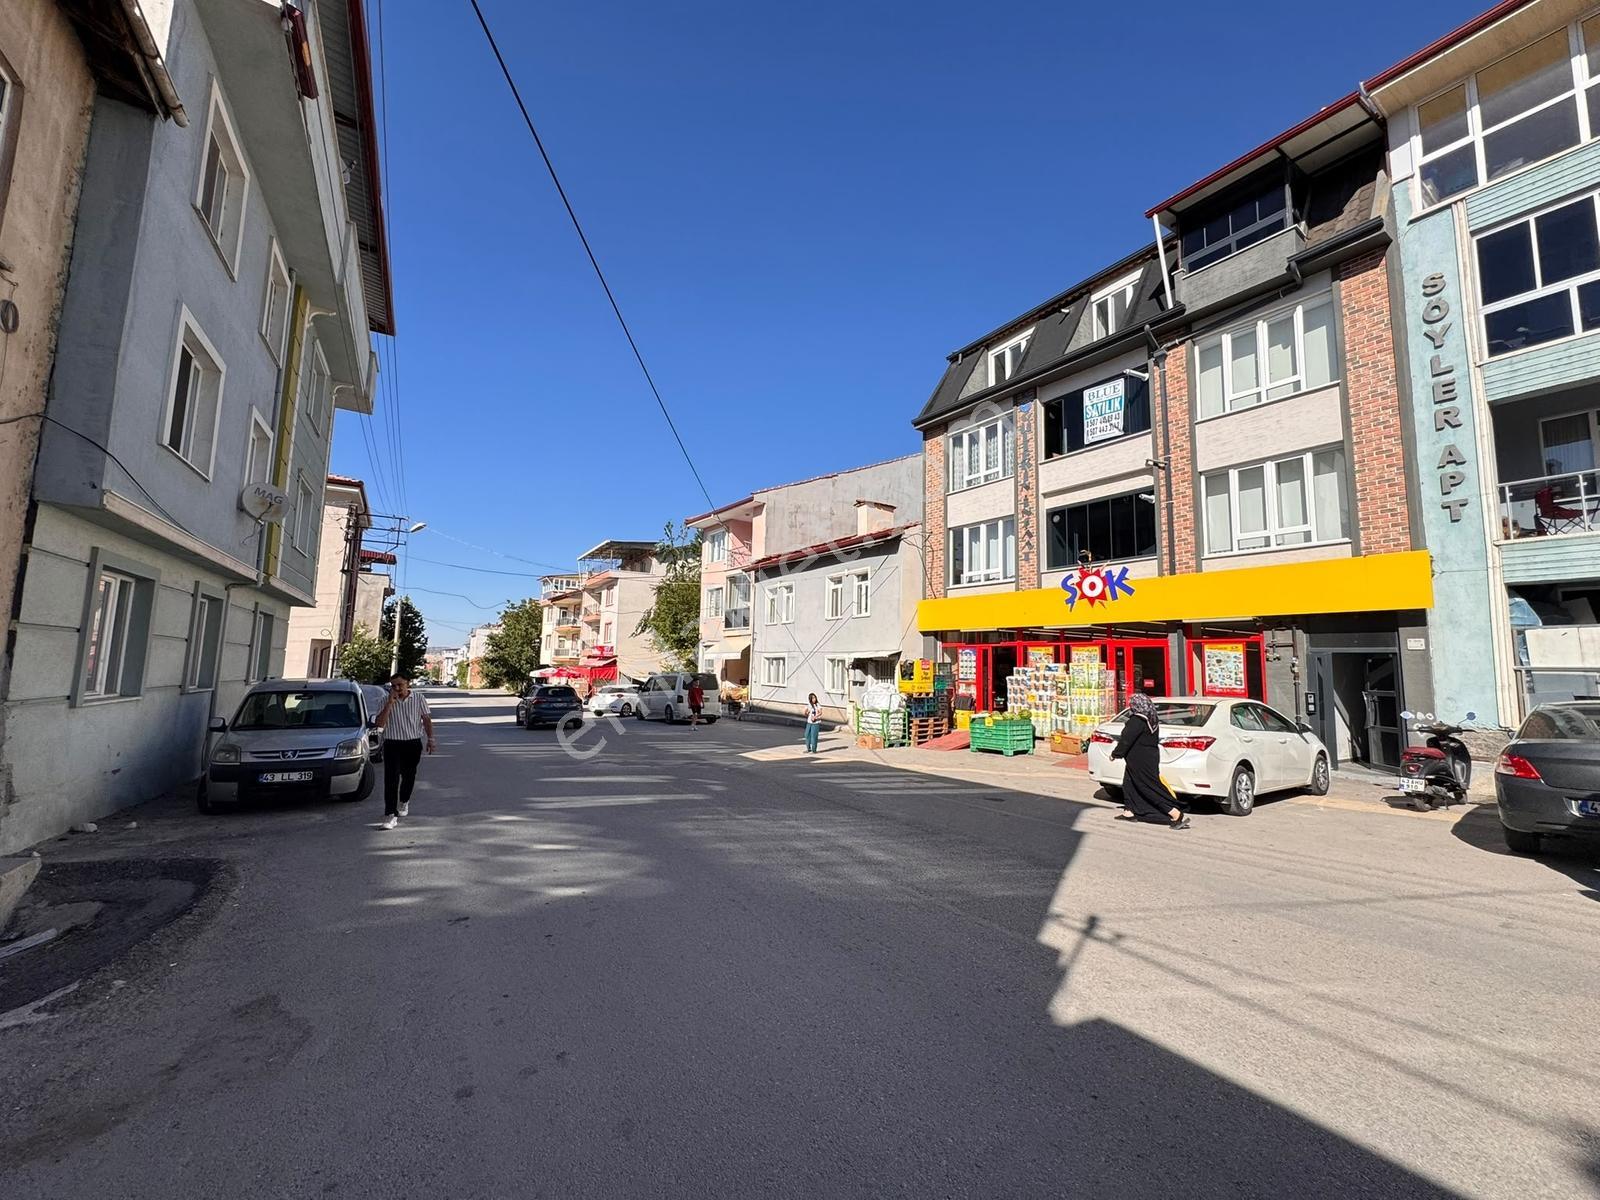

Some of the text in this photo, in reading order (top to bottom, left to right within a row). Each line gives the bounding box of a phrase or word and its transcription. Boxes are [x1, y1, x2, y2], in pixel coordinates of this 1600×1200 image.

[1087, 384, 1121, 401] BLUE
[1085, 396, 1122, 420] SATILIK
[1436, 443, 1470, 525] APT
[254, 487, 284, 505] MAG
[1061, 566, 1135, 612] ŞOK
[263, 771, 313, 783] 43 LL 319
